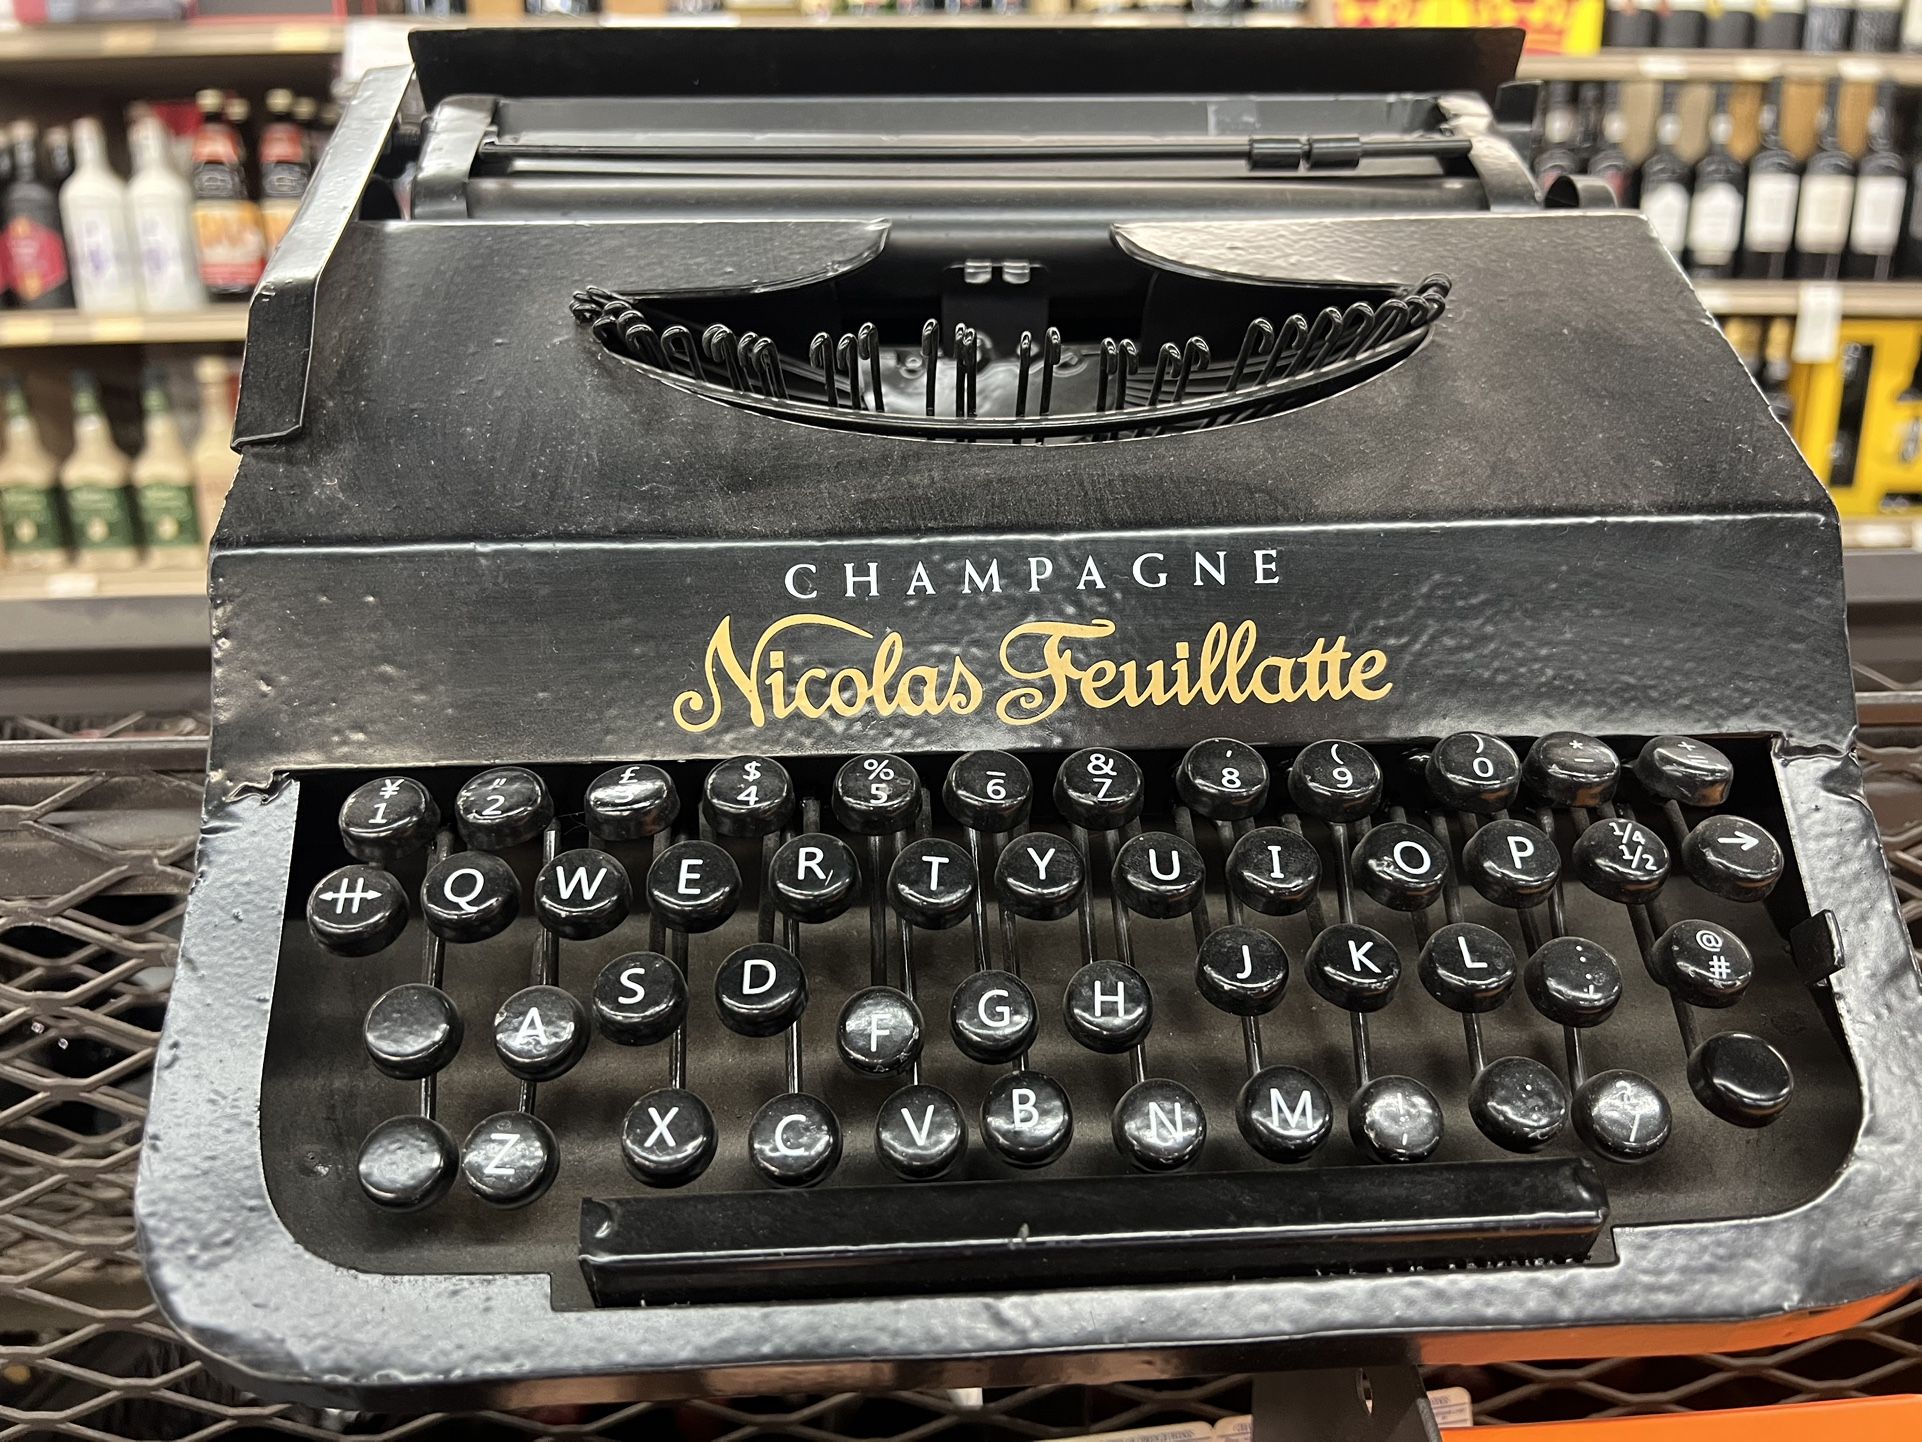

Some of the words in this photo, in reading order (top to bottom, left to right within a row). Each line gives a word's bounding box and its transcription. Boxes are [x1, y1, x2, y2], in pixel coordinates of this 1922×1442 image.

[784, 548, 1281, 599] CHAMPAGNE
[672, 613, 984, 733] Nicolas
[995, 618, 1394, 725] Feuillatte
[618, 766, 641, 784] £
[743, 760, 762, 783] $
[863, 759, 894, 781] %
[1087, 753, 1117, 776] &
[1221, 767, 1242, 789] 8
[1331, 766, 1354, 788] 9
[379, 778, 405, 799] ¥
[481, 795, 505, 816] 2
[736, 784, 760, 807] 4
[869, 783, 888, 805] 5
[985, 778, 1007, 800] 6
[1093, 777, 1112, 800] 7
[368, 802, 388, 824] 1
[796, 846, 827, 881] R
[1026, 847, 1056, 881] Y
[1148, 848, 1181, 881] U
[1267, 845, 1285, 878] I
[1393, 840, 1431, 875] O
[1506, 836, 1535, 869] P
[442, 867, 485, 914] Q
[554, 864, 608, 901] W
[676, 858, 704, 896] E
[921, 855, 950, 891] T
[1347, 940, 1382, 973] K
[1457, 935, 1489, 969] L
[1695, 929, 1723, 952] @
[742, 959, 777, 995] D
[1236, 944, 1253, 980] J
[1708, 955, 1732, 980] #
[617, 967, 646, 1004] S
[1093, 980, 1126, 1018] H
[977, 989, 1011, 1028] G
[514, 1006, 548, 1047] A
[869, 1012, 890, 1053] F
[900, 1103, 935, 1147] V
[1011, 1087, 1040, 1131] B
[1147, 1101, 1184, 1144] N
[1269, 1087, 1313, 1129] M
[643, 1106, 680, 1149] X
[774, 1114, 807, 1157] C
[484, 1132, 521, 1176] Z
